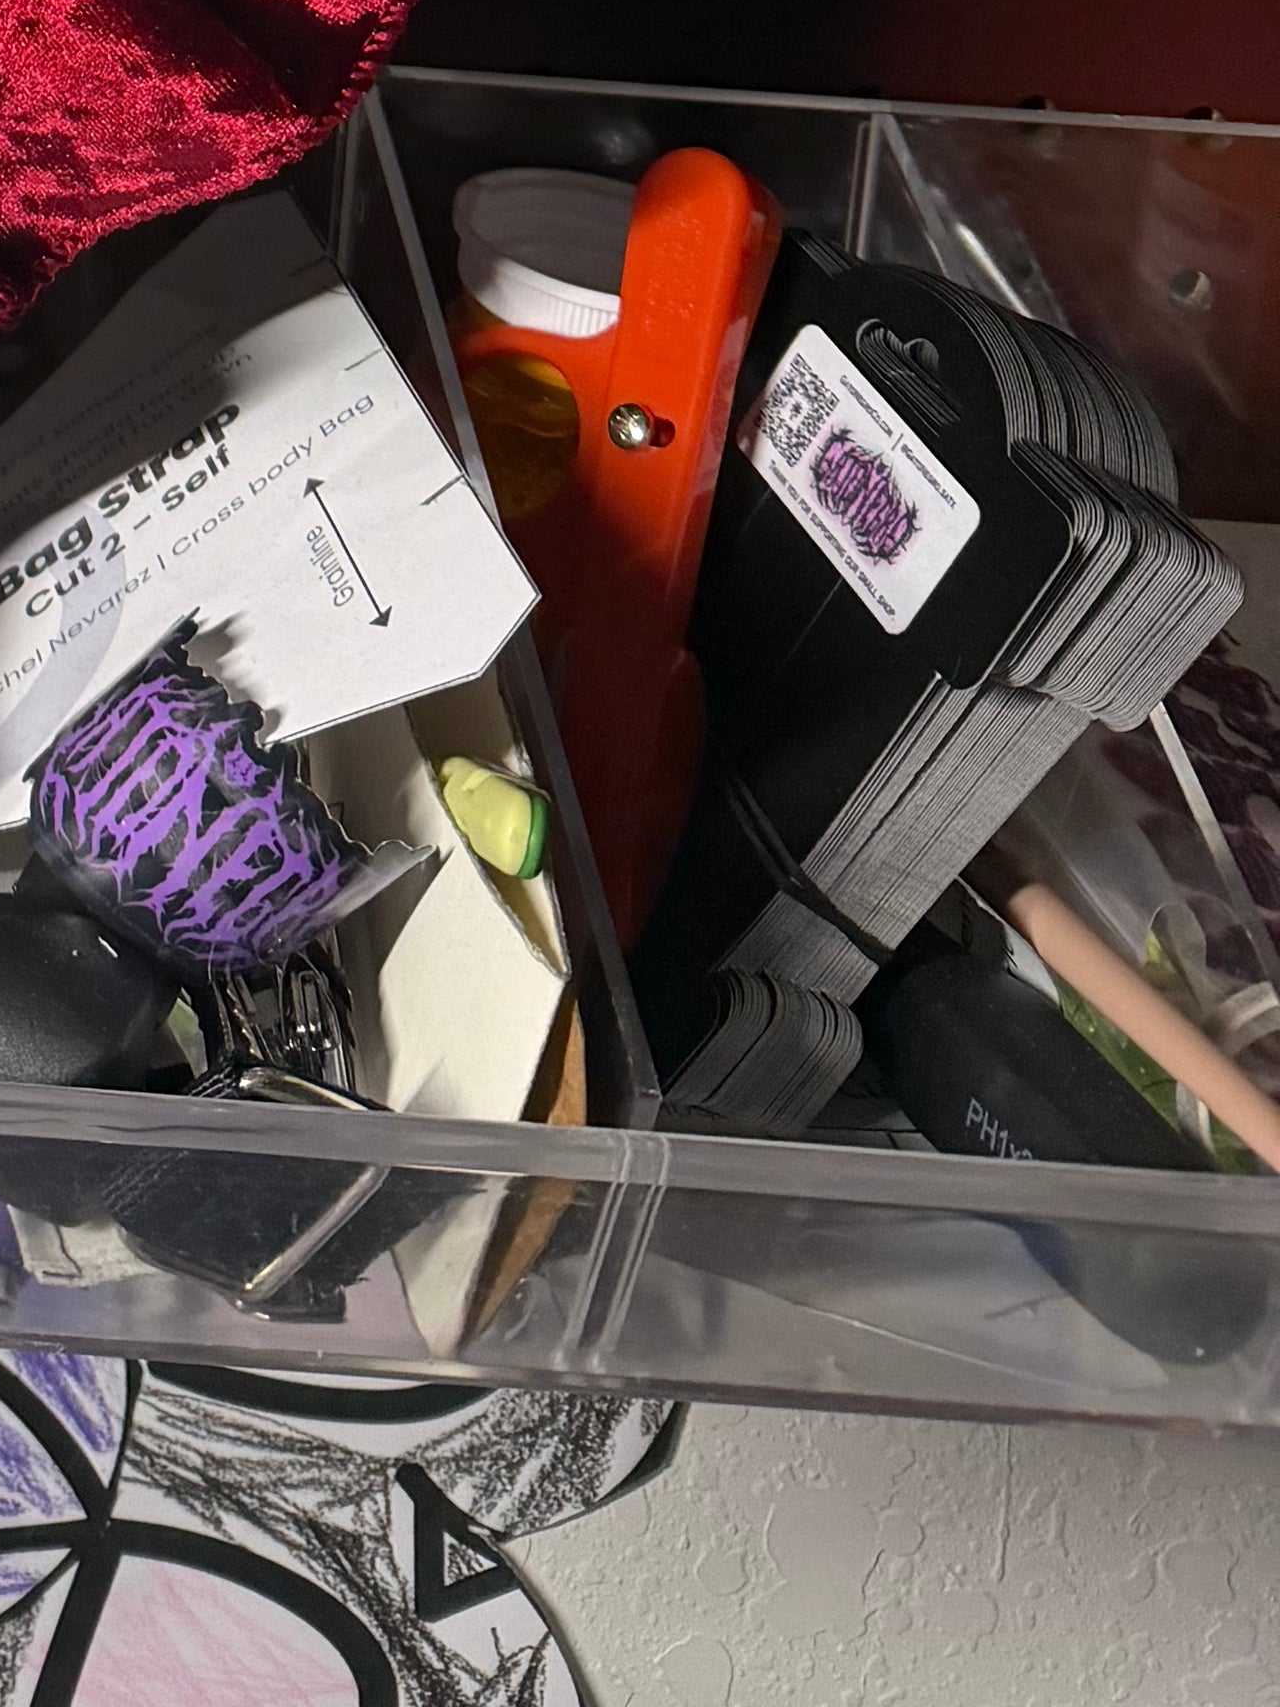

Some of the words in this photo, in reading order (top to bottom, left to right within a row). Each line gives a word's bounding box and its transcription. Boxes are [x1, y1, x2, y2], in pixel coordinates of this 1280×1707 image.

[26, 556, 96, 618] Cut
[100, 532, 127, 562] 2
[161, 442, 231, 512] Self
[48, 566, 152, 653] Nevarez
[171, 495, 245, 556] Cross
[248, 435, 313, 496] body
[318, 394, 375, 438] Bag
[98, 403, 240, 519] Strap
[306, 524, 355, 608] Grainline
